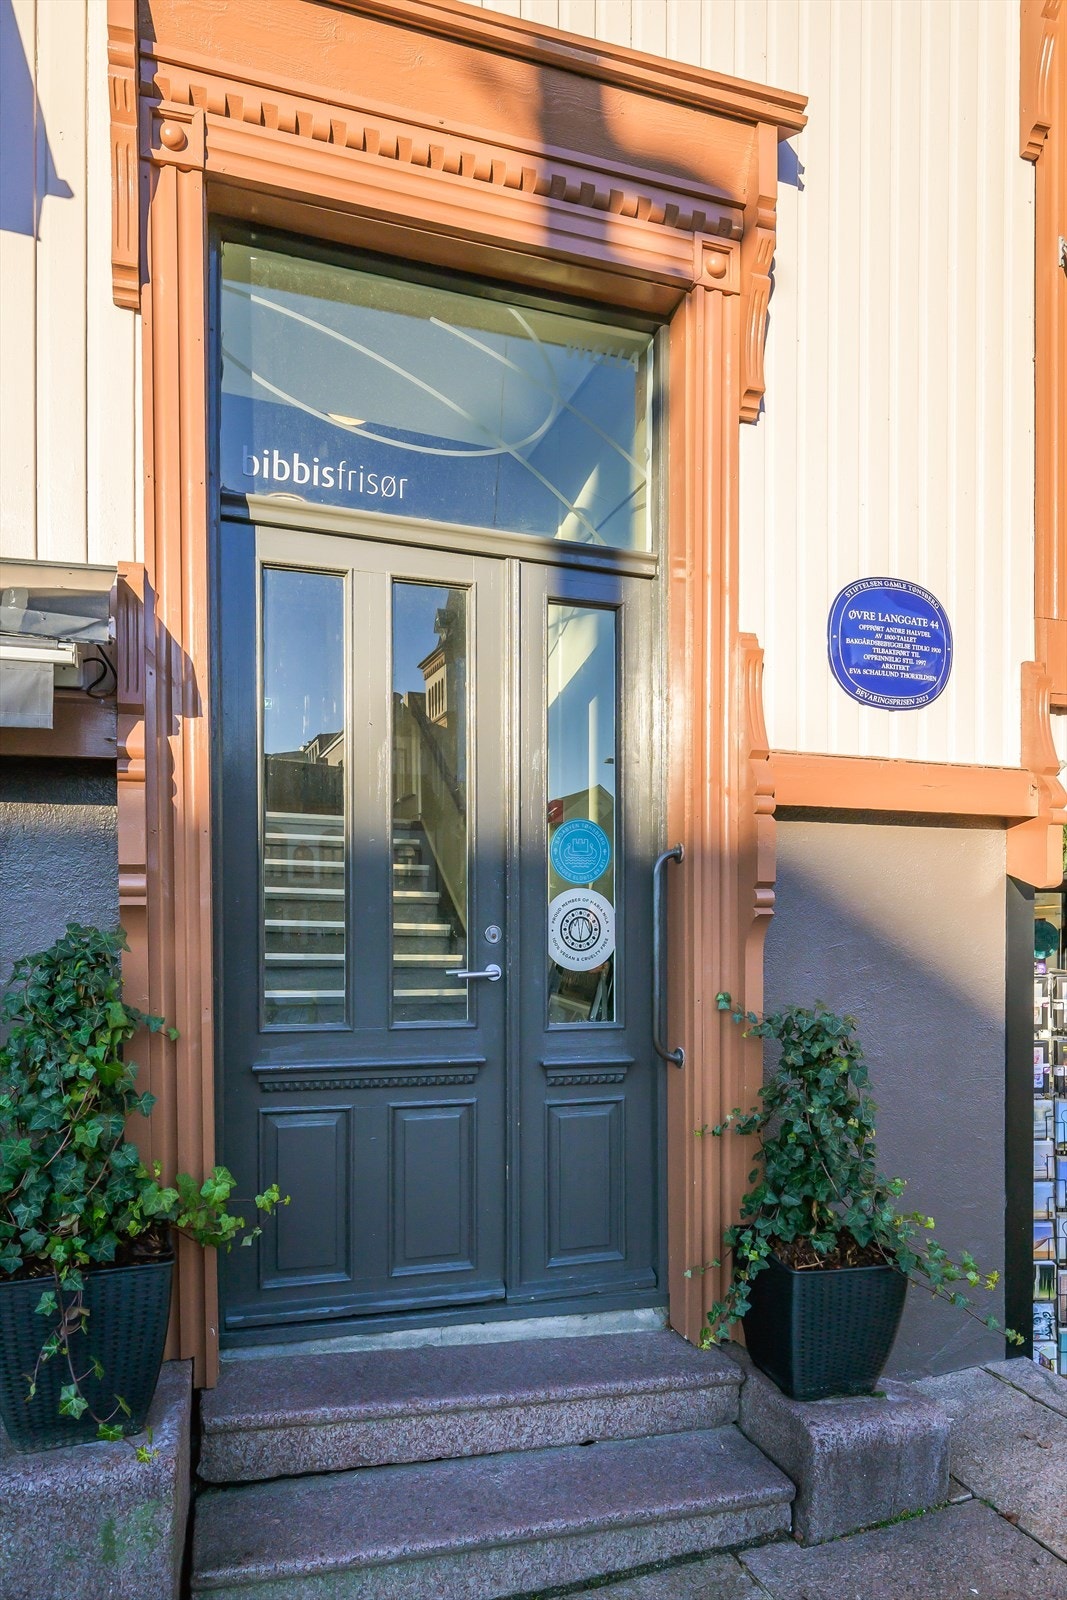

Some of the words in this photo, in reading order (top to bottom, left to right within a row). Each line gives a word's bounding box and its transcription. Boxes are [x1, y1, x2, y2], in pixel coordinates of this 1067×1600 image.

[844, 581, 883, 598] STIFTELSEN
[884, 580, 907, 590] GAMLE
[908, 586, 940, 609] TØNSBERG
[848, 609, 876, 620] ØVRE
[878, 612, 928, 627] LANGGATE
[930, 620, 939, 630] 44
[859, 624, 884, 632] OPPFØRT
[885, 627, 905, 635] ANDRE
[906, 629, 931, 638] HALVDEL
[884, 634, 917, 643] 1800-TALLET
[912, 644, 930, 652] TIDLIG
[881, 663, 910, 671] ARKITEKT
[902, 657, 914, 665] STIL
[855, 687, 915, 706] BEVARINGSPRISEN
[916, 694, 929, 704] 2023
[551, 907, 562, 925] PROUD
[561, 897, 581, 908] MEMBER
[590, 900, 603, 913] MARIA
[552, 937, 560, 950] 100%
[560, 950, 575, 961] VEGAN
[581, 950, 601, 961] CRUELTY
[600, 938, 609, 950] FREE
